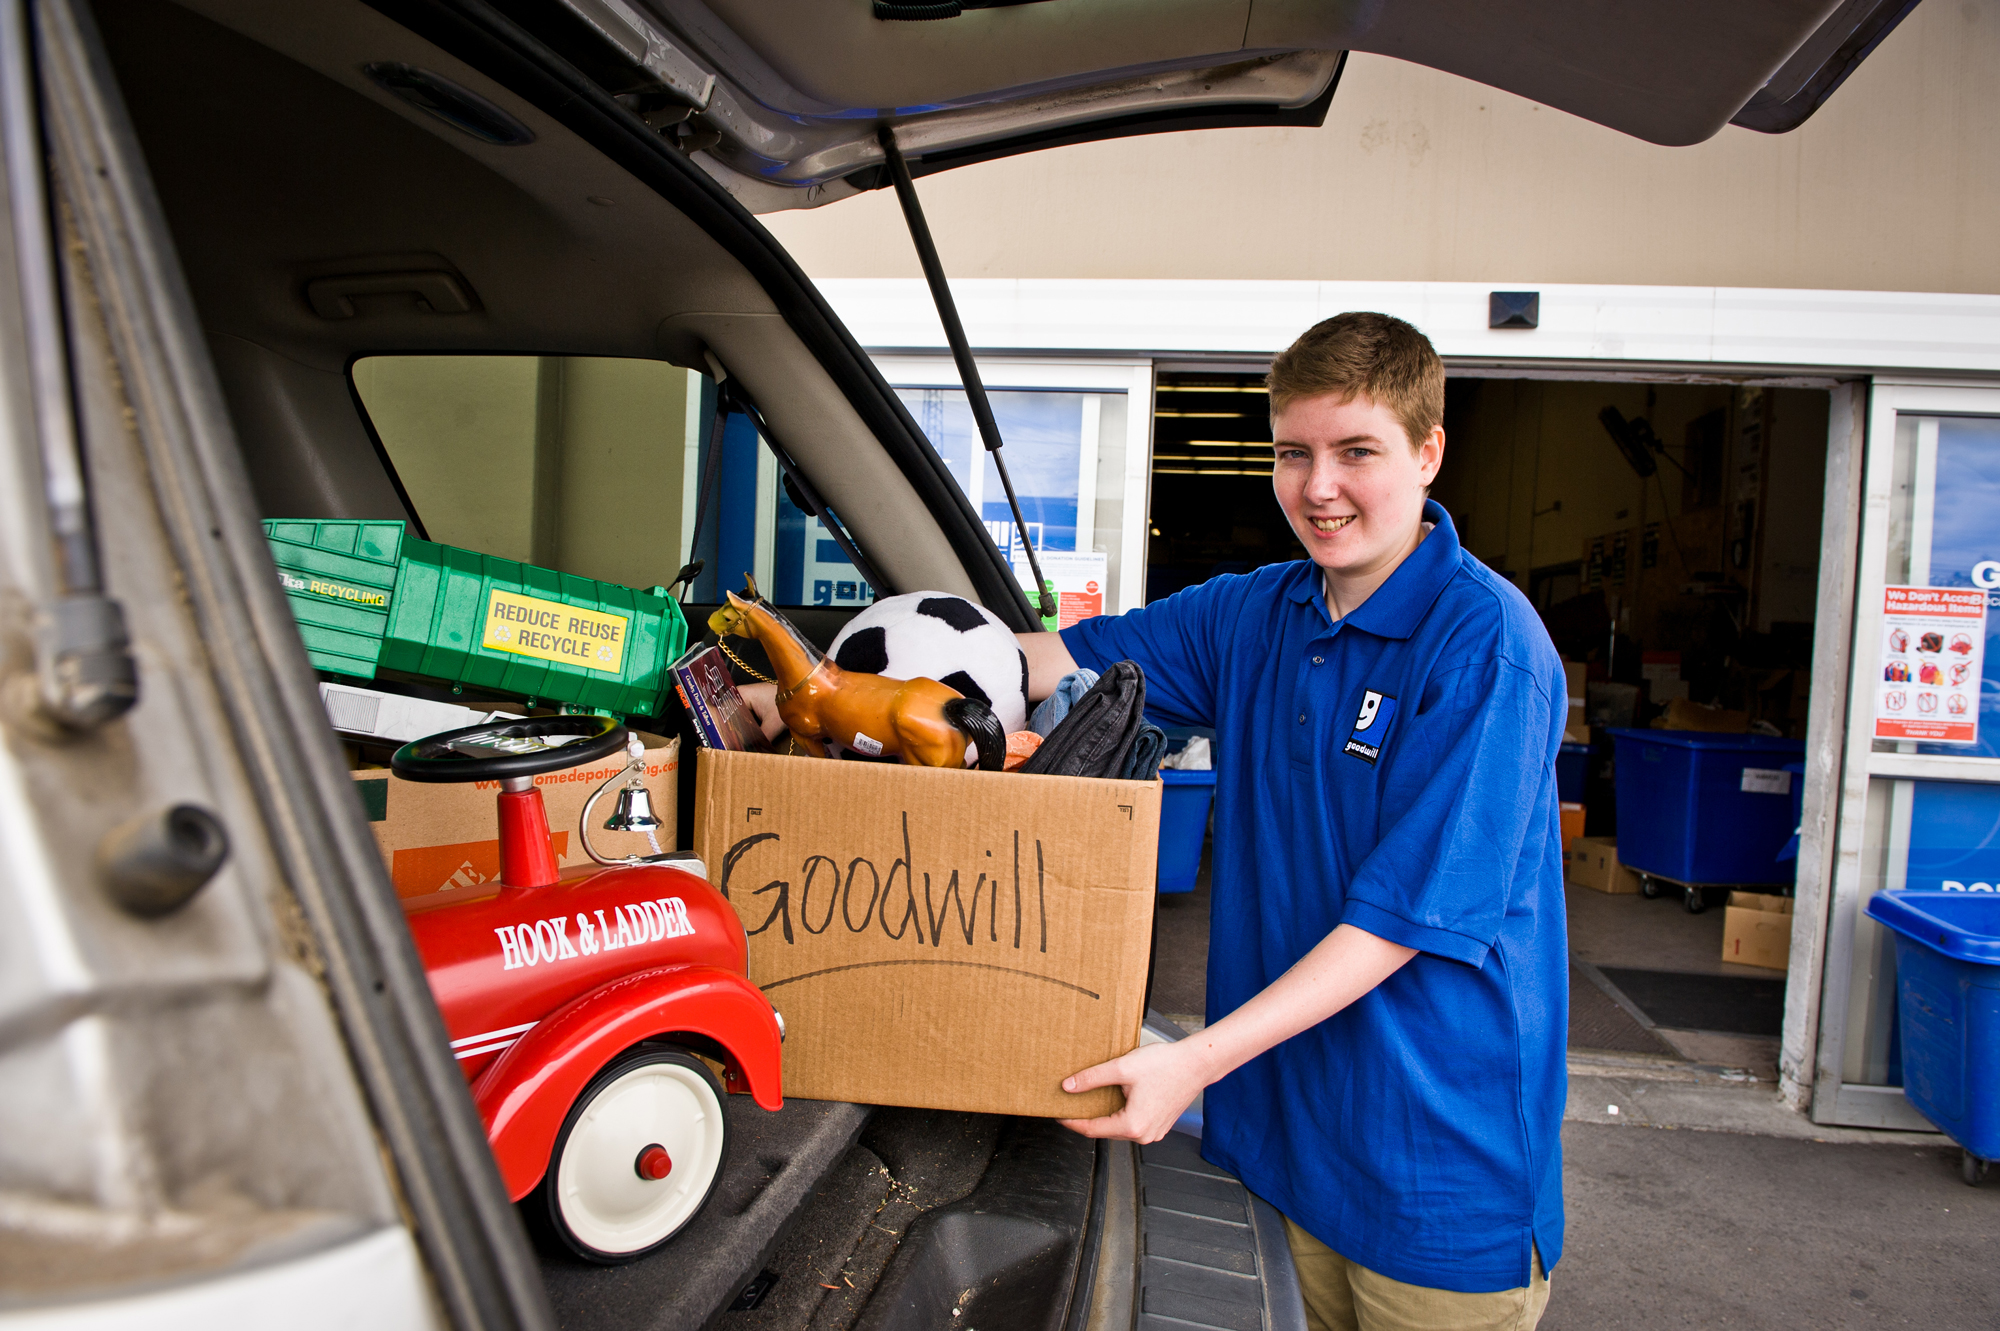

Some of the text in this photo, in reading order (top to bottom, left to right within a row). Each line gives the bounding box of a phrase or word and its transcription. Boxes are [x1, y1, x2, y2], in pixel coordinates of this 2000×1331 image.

[310, 580, 385, 606] RECYCLING
[1886, 590, 1906, 600] We
[1908, 591, 1939, 601] Don't
[1886, 601, 1981, 614] Hazardous Items
[494, 602, 620, 642] REDUCE REUSE
[518, 629, 591, 658] RECYCLE
[675, 685, 691, 709] SINGER
[1345, 742, 1379, 759] goodwill
[721, 811, 1047, 953] Goodwill
[494, 897, 696, 971] HOOK & LADDER
